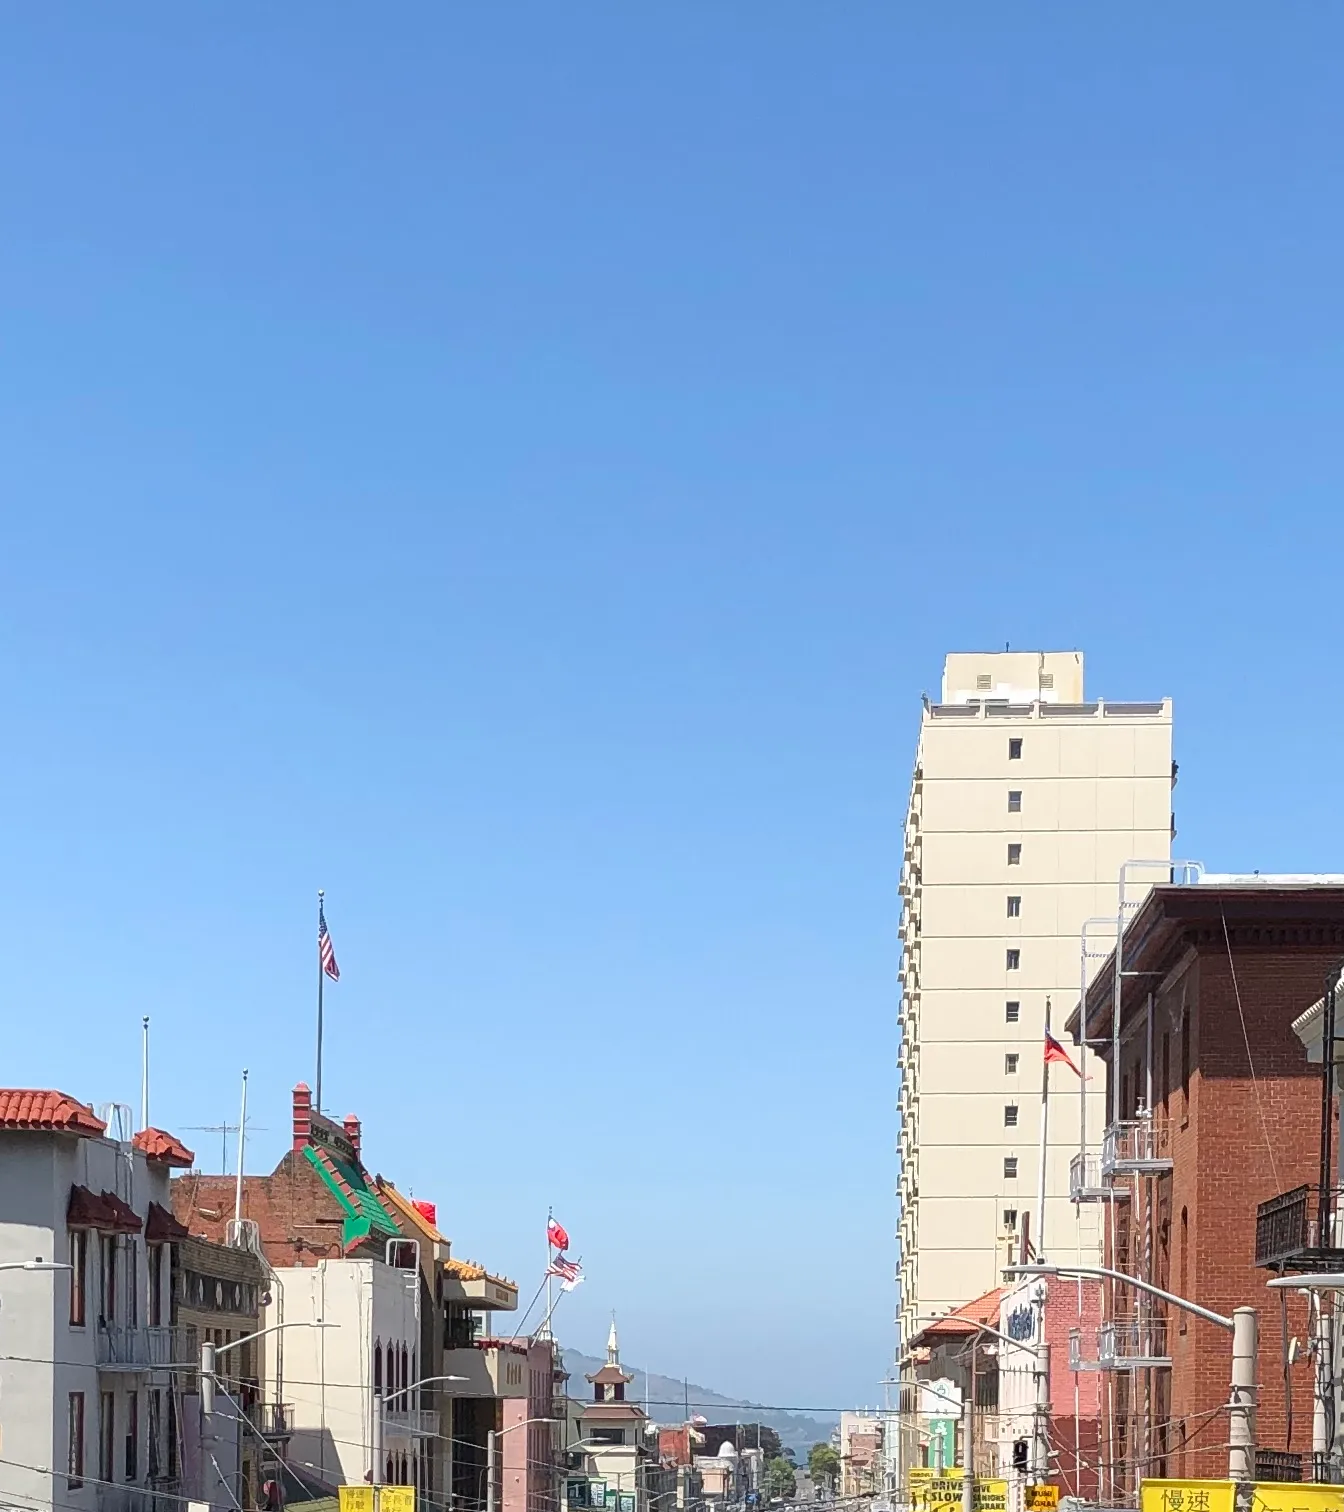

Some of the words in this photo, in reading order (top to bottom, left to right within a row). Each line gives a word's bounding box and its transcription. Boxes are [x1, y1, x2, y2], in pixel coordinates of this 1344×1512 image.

[932, 1481, 963, 1490] DRIVE
[931, 1493, 963, 1501] SLOW
[1161, 1489, 1210, 1512] 慢速
